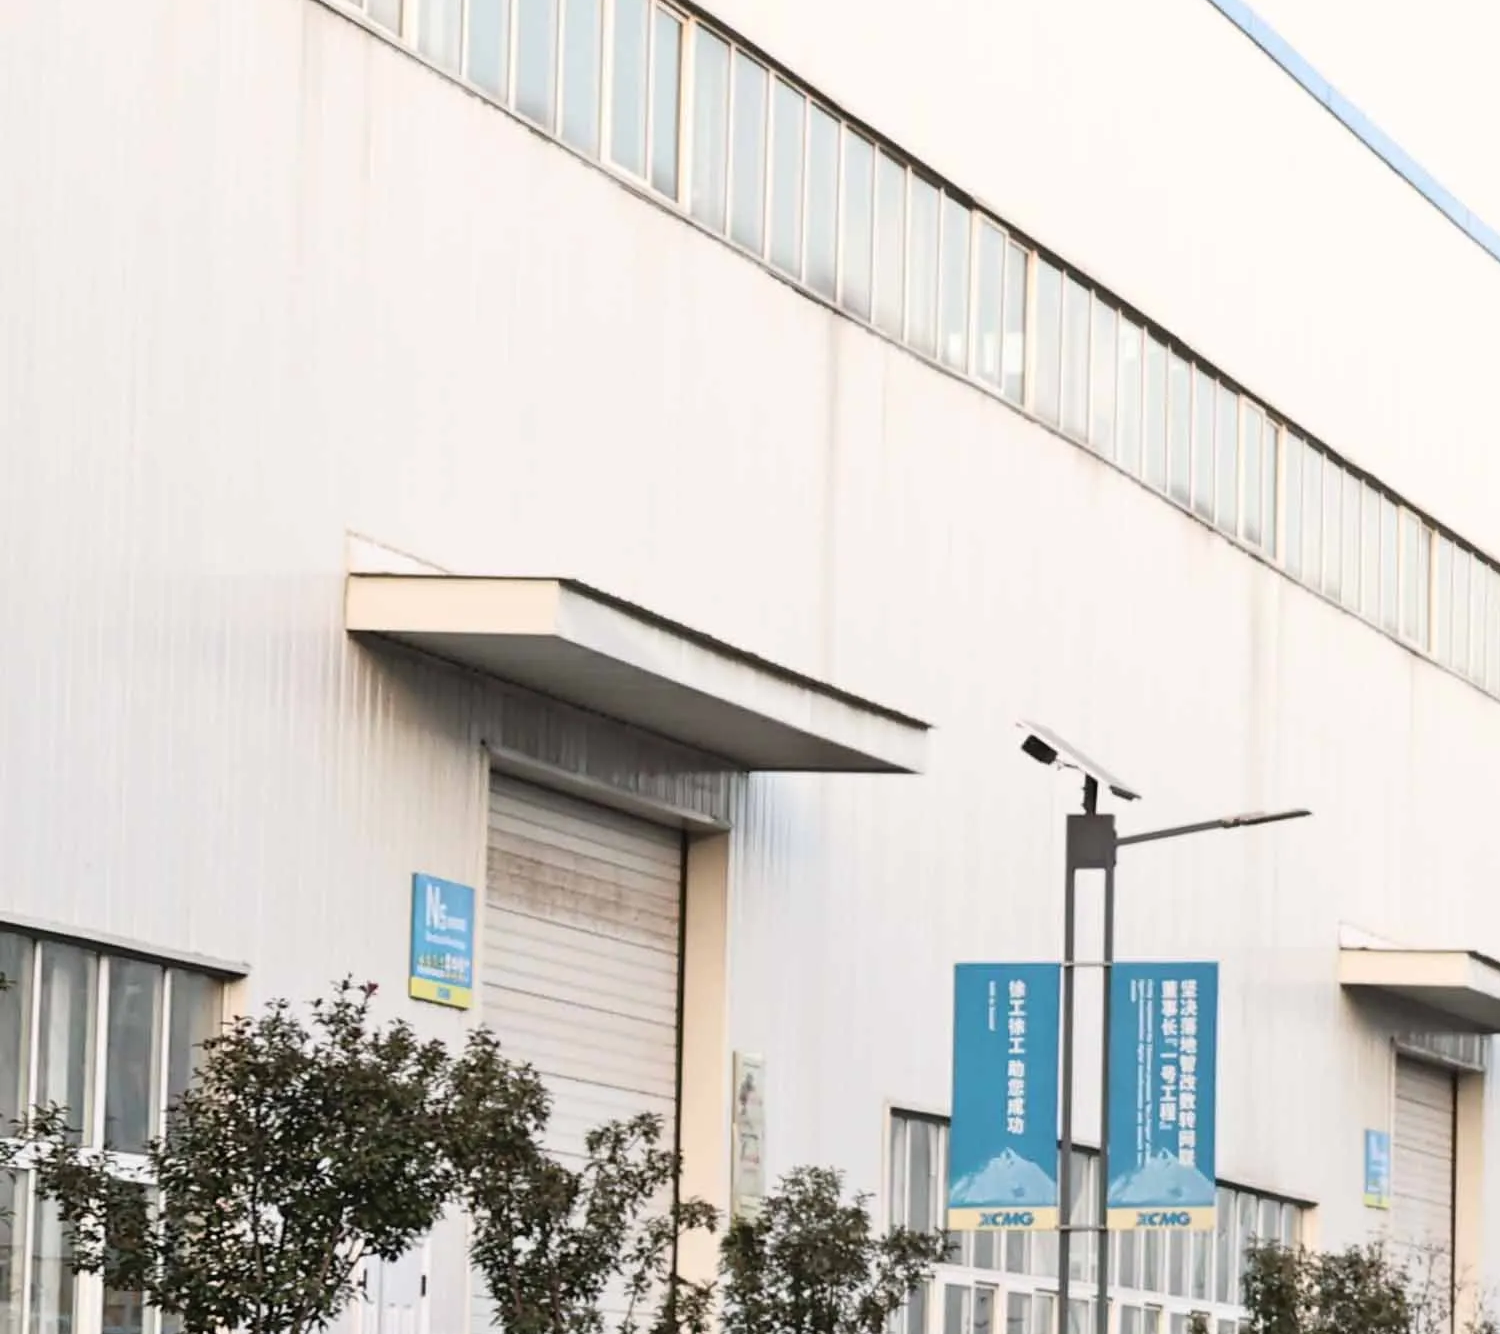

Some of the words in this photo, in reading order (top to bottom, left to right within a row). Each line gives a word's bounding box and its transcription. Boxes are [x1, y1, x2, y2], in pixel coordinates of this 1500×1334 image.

[1008, 979, 1026, 1054] 徐工徐工
[979, 1212, 1035, 1227] XCMG
[1136, 1212, 1192, 1227] XCMG
